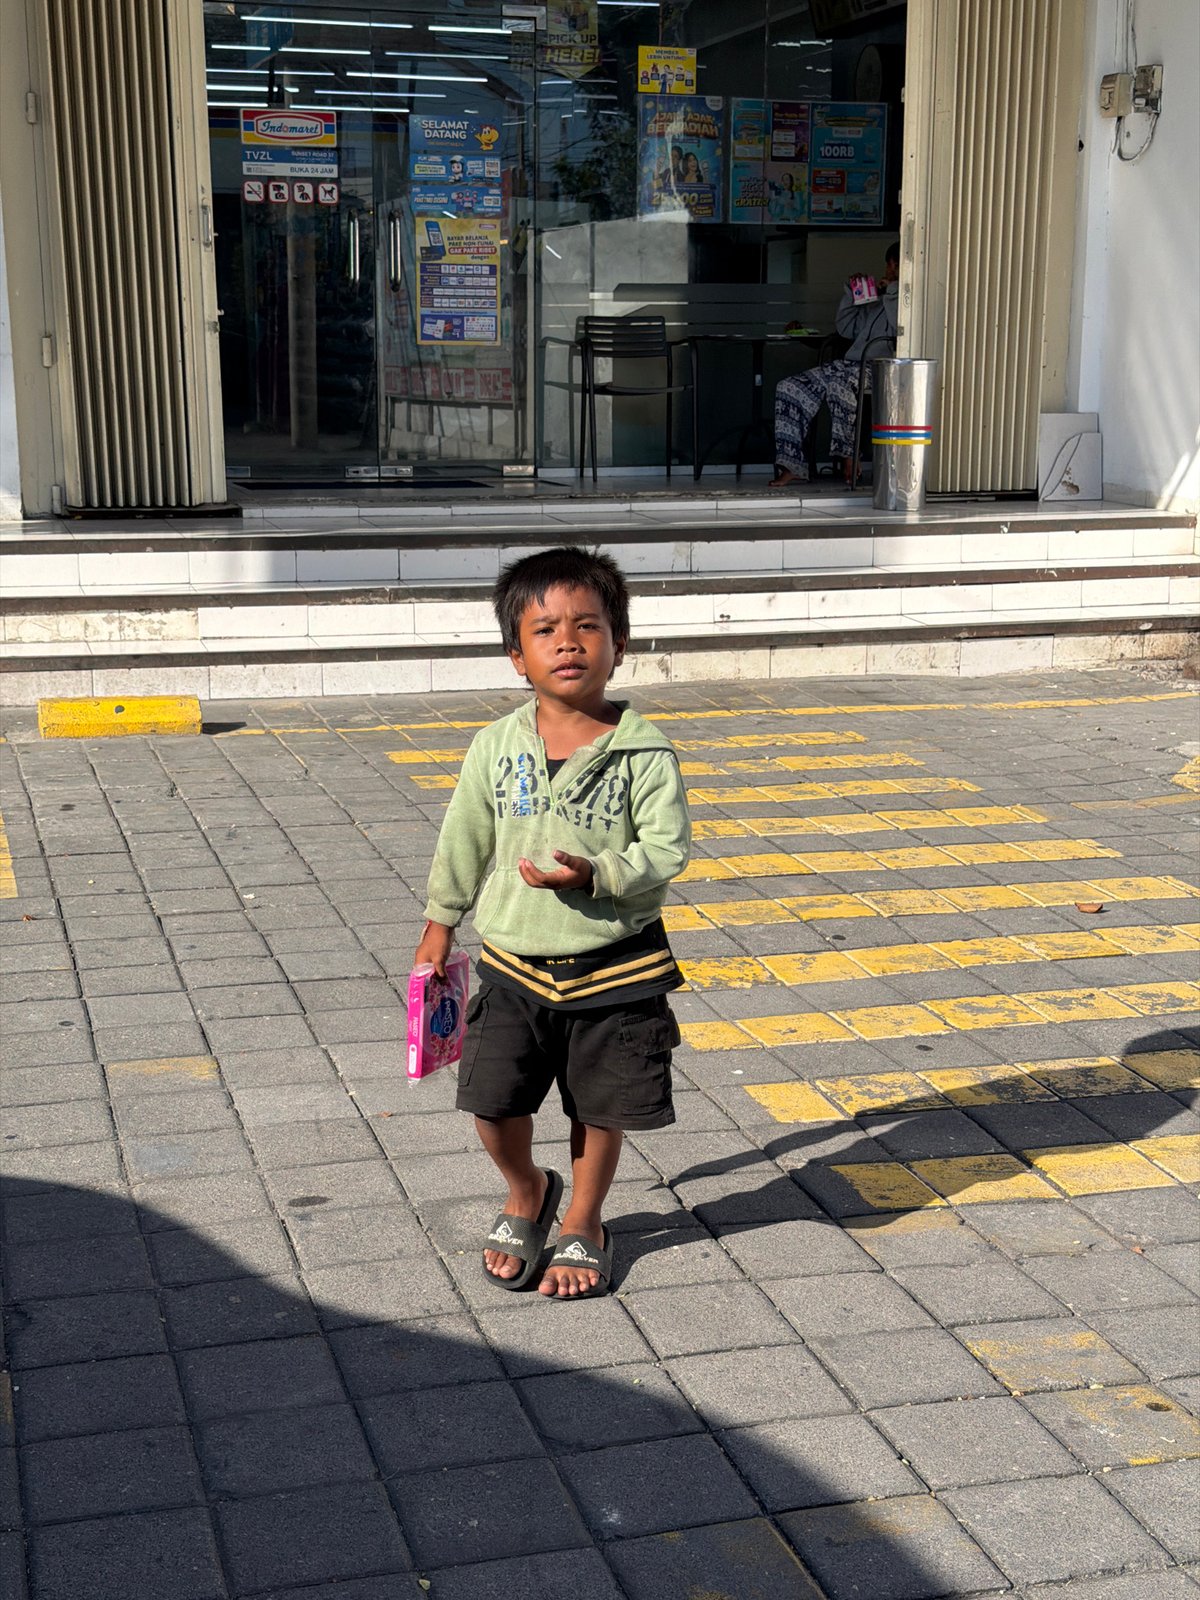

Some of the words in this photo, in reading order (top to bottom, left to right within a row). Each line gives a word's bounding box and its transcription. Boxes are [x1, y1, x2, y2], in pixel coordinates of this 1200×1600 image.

[549, 34, 577, 44] PICK
[580, 34, 597, 44] UP
[545, 48, 601, 63] HERE!
[260, 120, 319, 134] Indomaret
[421, 119, 469, 130] SELAMAT
[424, 129, 467, 140] DATANG
[245, 150, 273, 161] TVZL
[819, 145, 855, 157] 100RB
[289, 166, 309, 174] BUKA
[443, 1000, 454, 1034] PASEO
